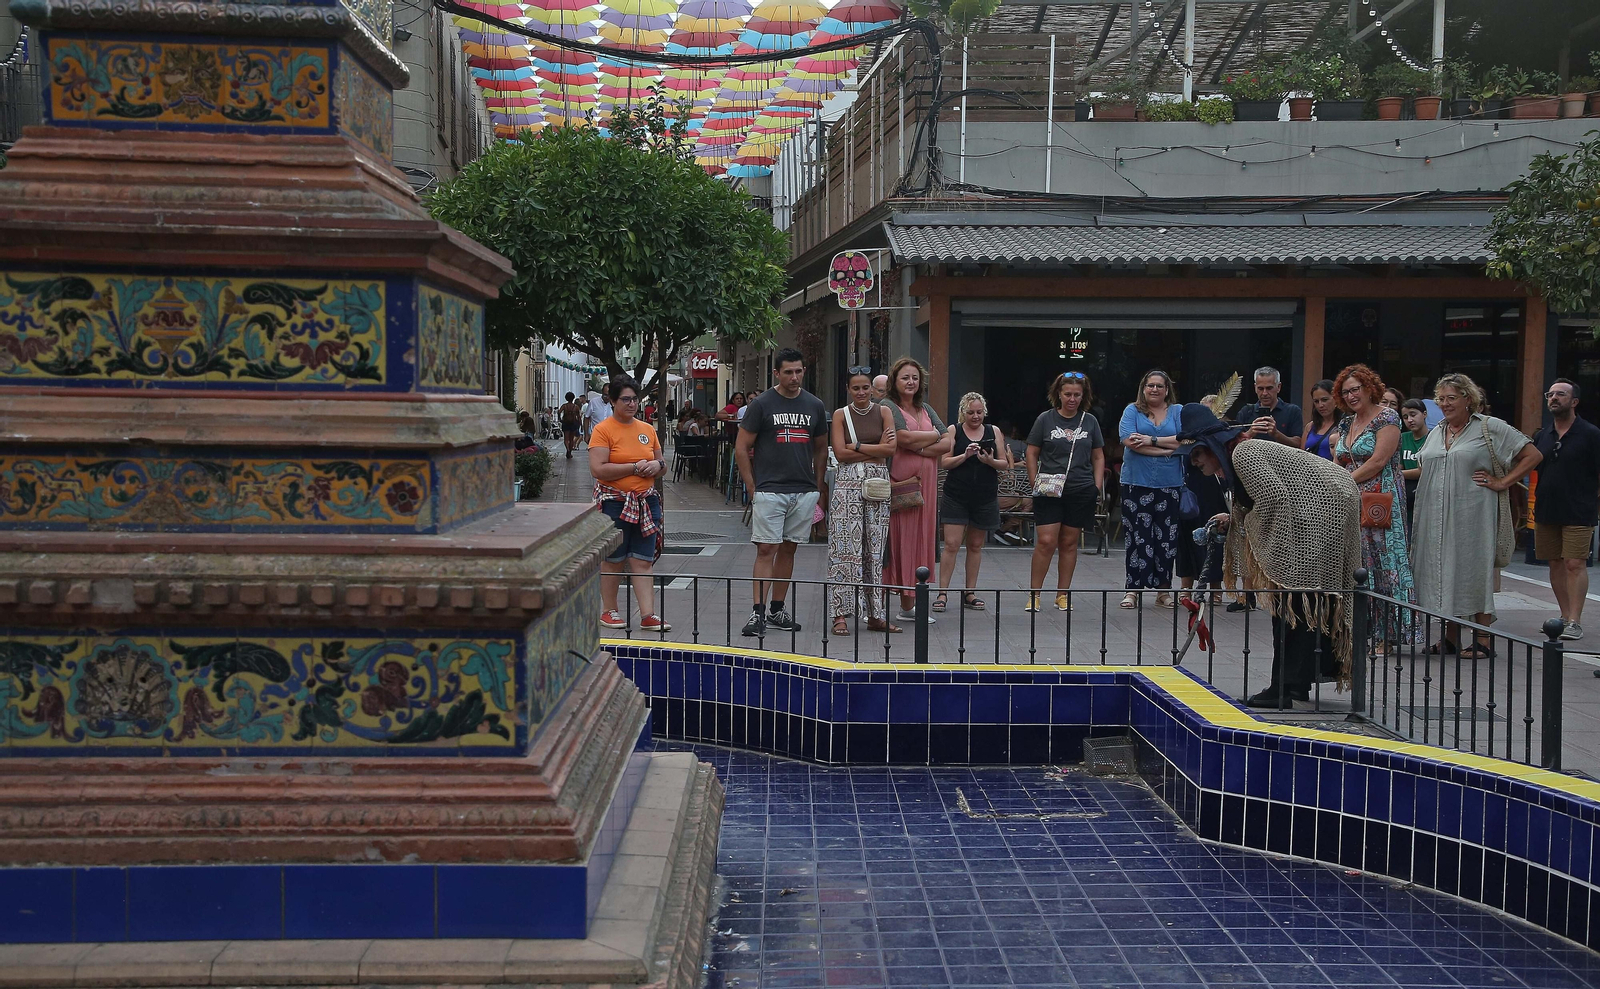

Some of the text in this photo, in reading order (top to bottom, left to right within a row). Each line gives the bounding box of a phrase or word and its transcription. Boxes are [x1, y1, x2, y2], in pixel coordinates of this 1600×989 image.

[1060, 341, 1087, 349] SITOS
[692, 355, 718, 369] tele
[772, 413, 811, 426] NORWAY
